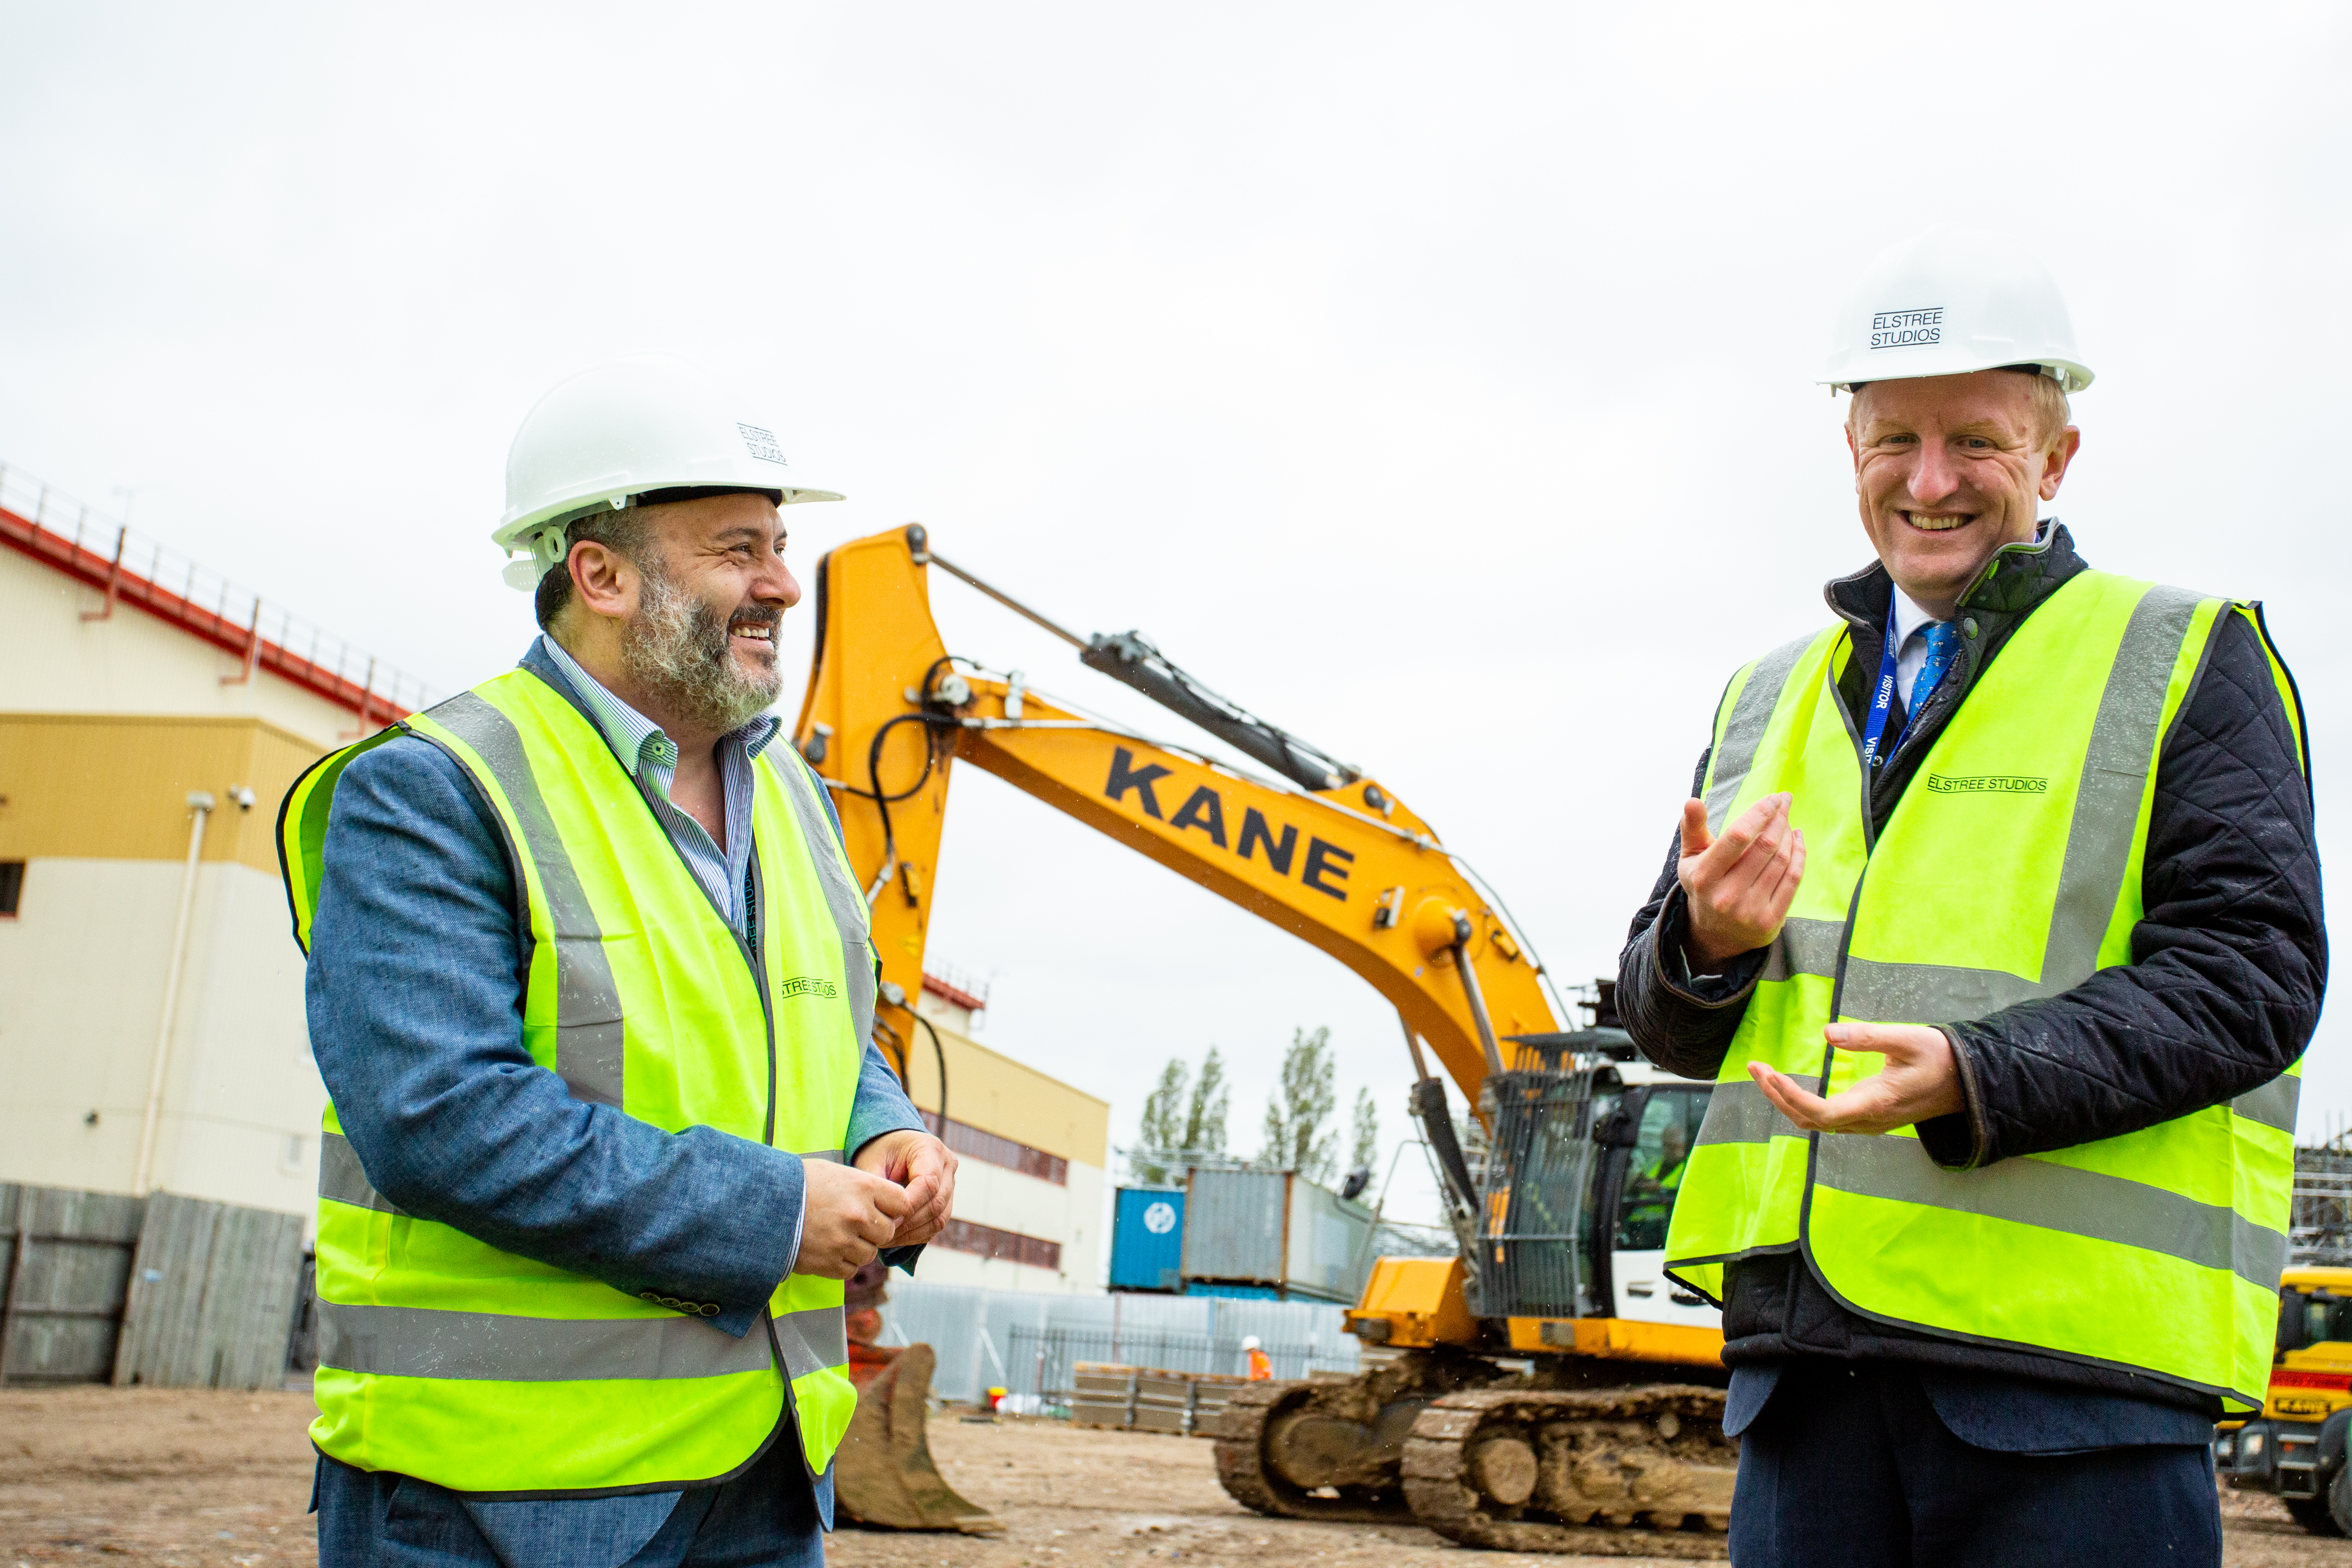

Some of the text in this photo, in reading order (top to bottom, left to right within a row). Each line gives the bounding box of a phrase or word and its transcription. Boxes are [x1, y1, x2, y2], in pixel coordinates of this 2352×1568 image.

[1873, 312, 1943, 329] ELSTREE
[1871, 328, 1940, 345] STUDIOS
[739, 426, 779, 447] ELSTREE
[747, 443, 786, 463] STUDIOS
[1876, 675, 1894, 709] VISITOR
[1928, 776, 2047, 791] ELSTREE STUDIOS
[1104, 745, 1355, 903] KANE
